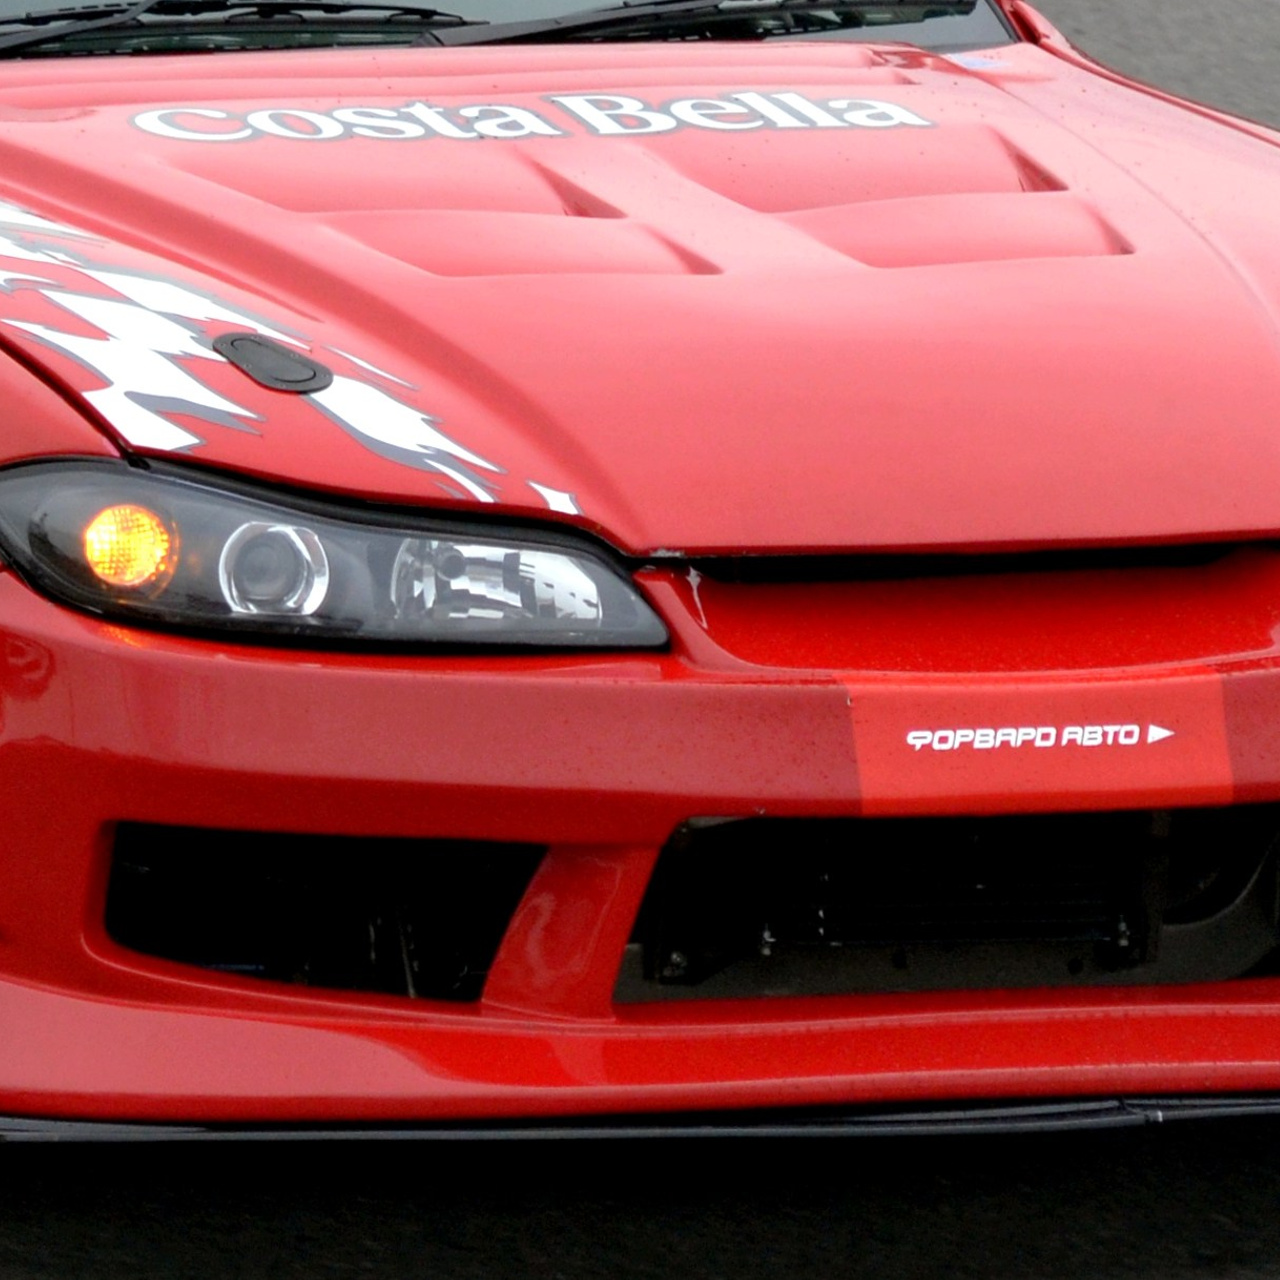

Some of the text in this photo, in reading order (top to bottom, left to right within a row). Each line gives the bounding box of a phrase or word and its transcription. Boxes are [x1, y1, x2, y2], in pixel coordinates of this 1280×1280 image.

[133, 92, 932, 141] Costa Bella
[1061, 724, 1140, 746] АВТО
